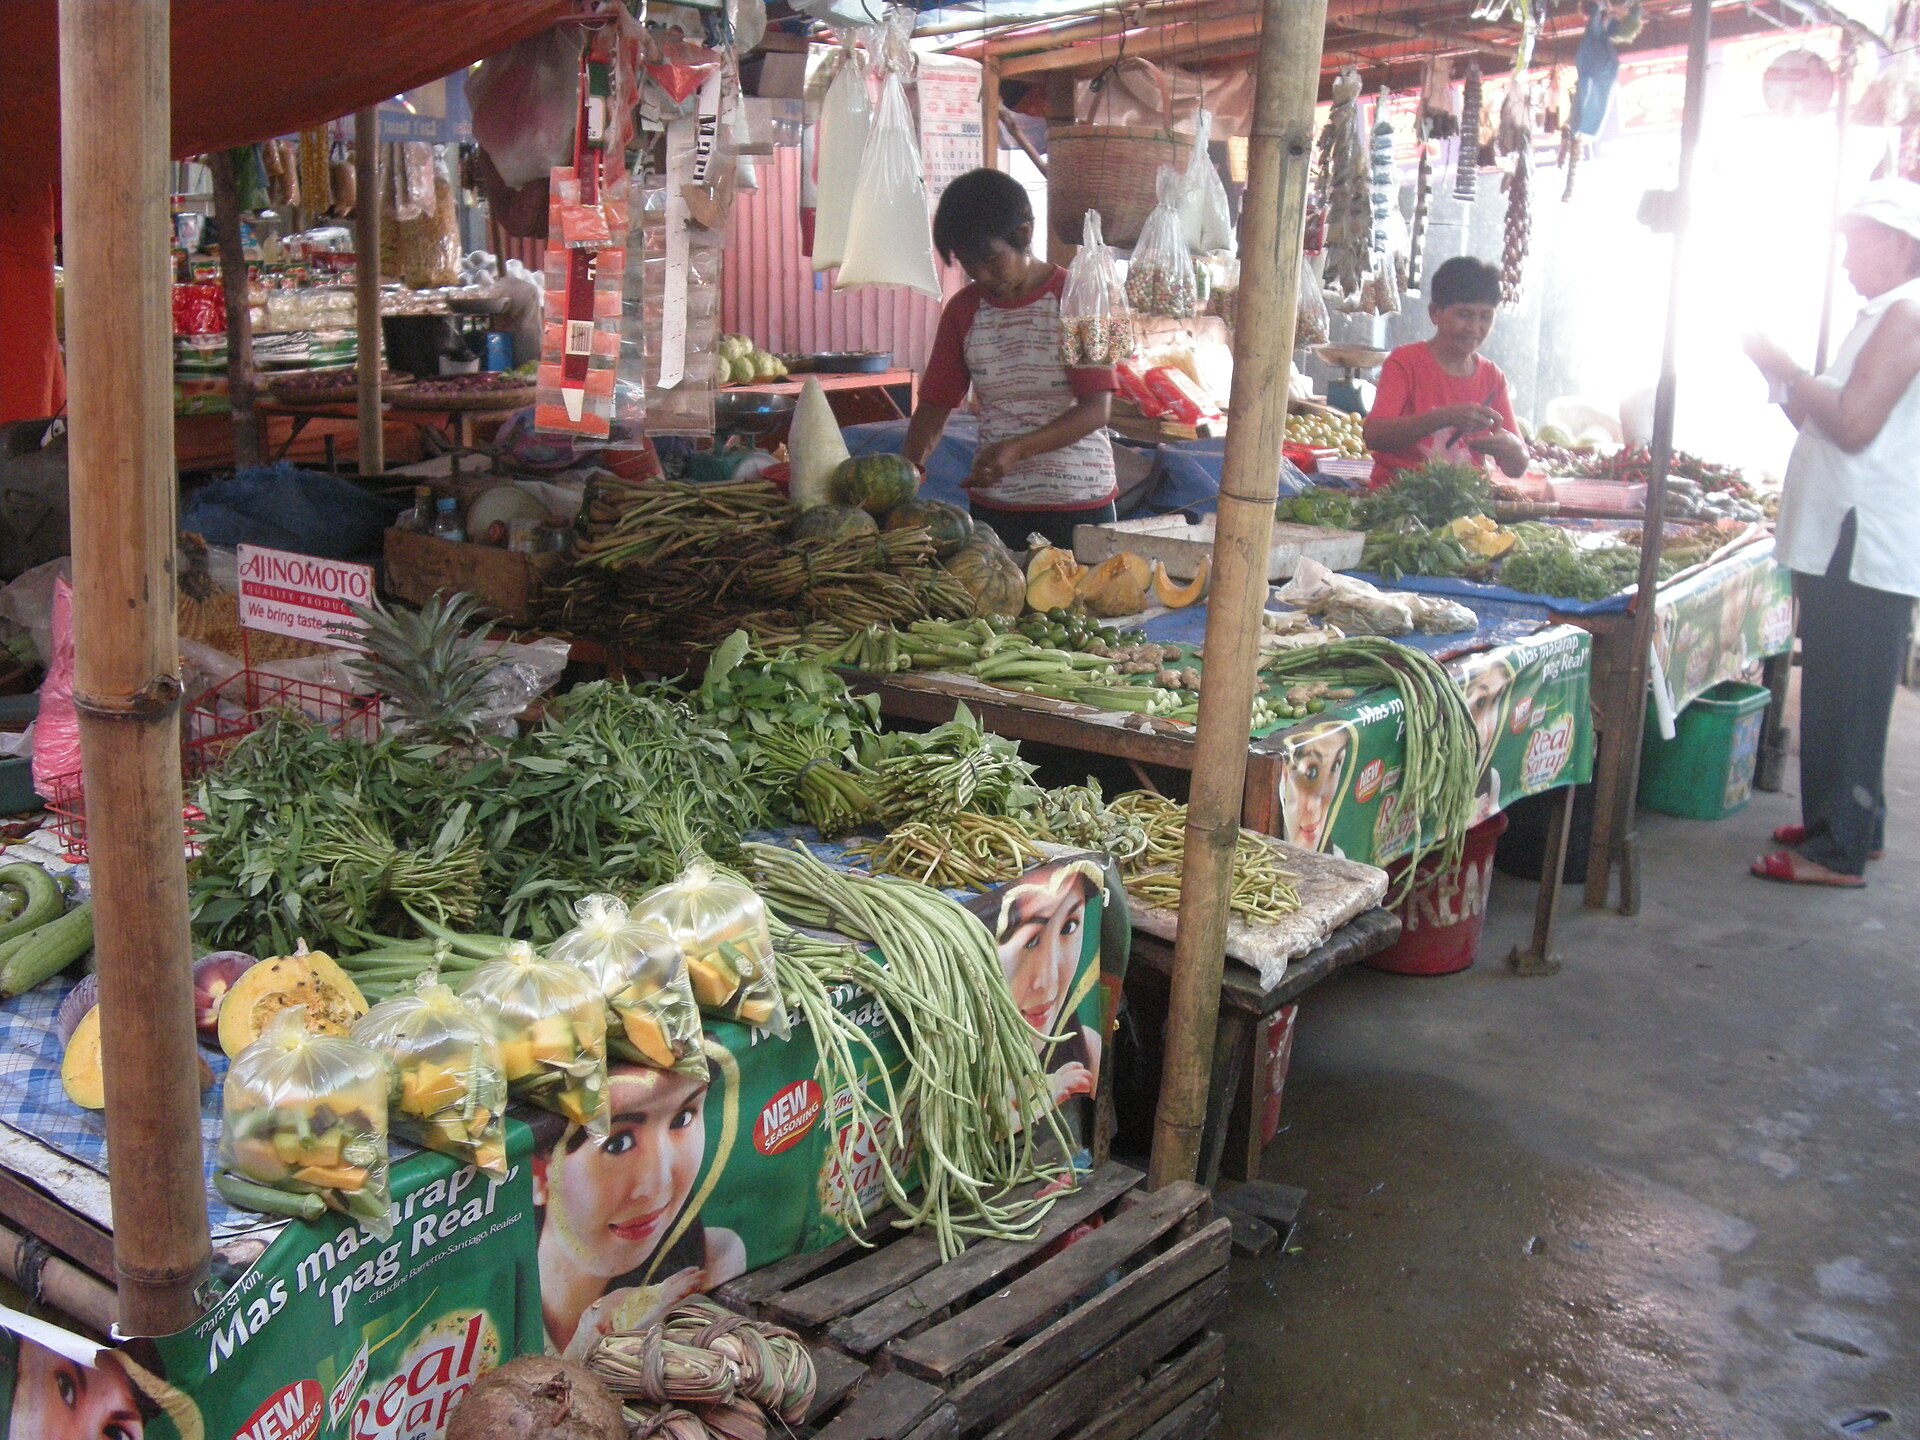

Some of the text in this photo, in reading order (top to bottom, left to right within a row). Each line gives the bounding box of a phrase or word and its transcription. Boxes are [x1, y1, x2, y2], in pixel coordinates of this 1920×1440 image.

[240, 554, 368, 598] AJINOMOTO
[246, 584, 353, 613] QUALITY PRODUC
[248, 602, 264, 618] We
[266, 605, 294, 628] bring
[297, 613, 323, 631] taste
[1515, 635, 1580, 669] Mas masarap
[1356, 703, 1389, 727] Mas
[1527, 717, 1573, 760] Real
[1360, 760, 1382, 788] NEW
[763, 1080, 808, 1137] NEW
[764, 1101, 819, 1151] SEASONING
[489, 1210, 523, 1236] Realista
[227, 1293, 240, 1311] sa
[208, 1278, 288, 1375] Mas
[350, 1313, 484, 1440] Real
